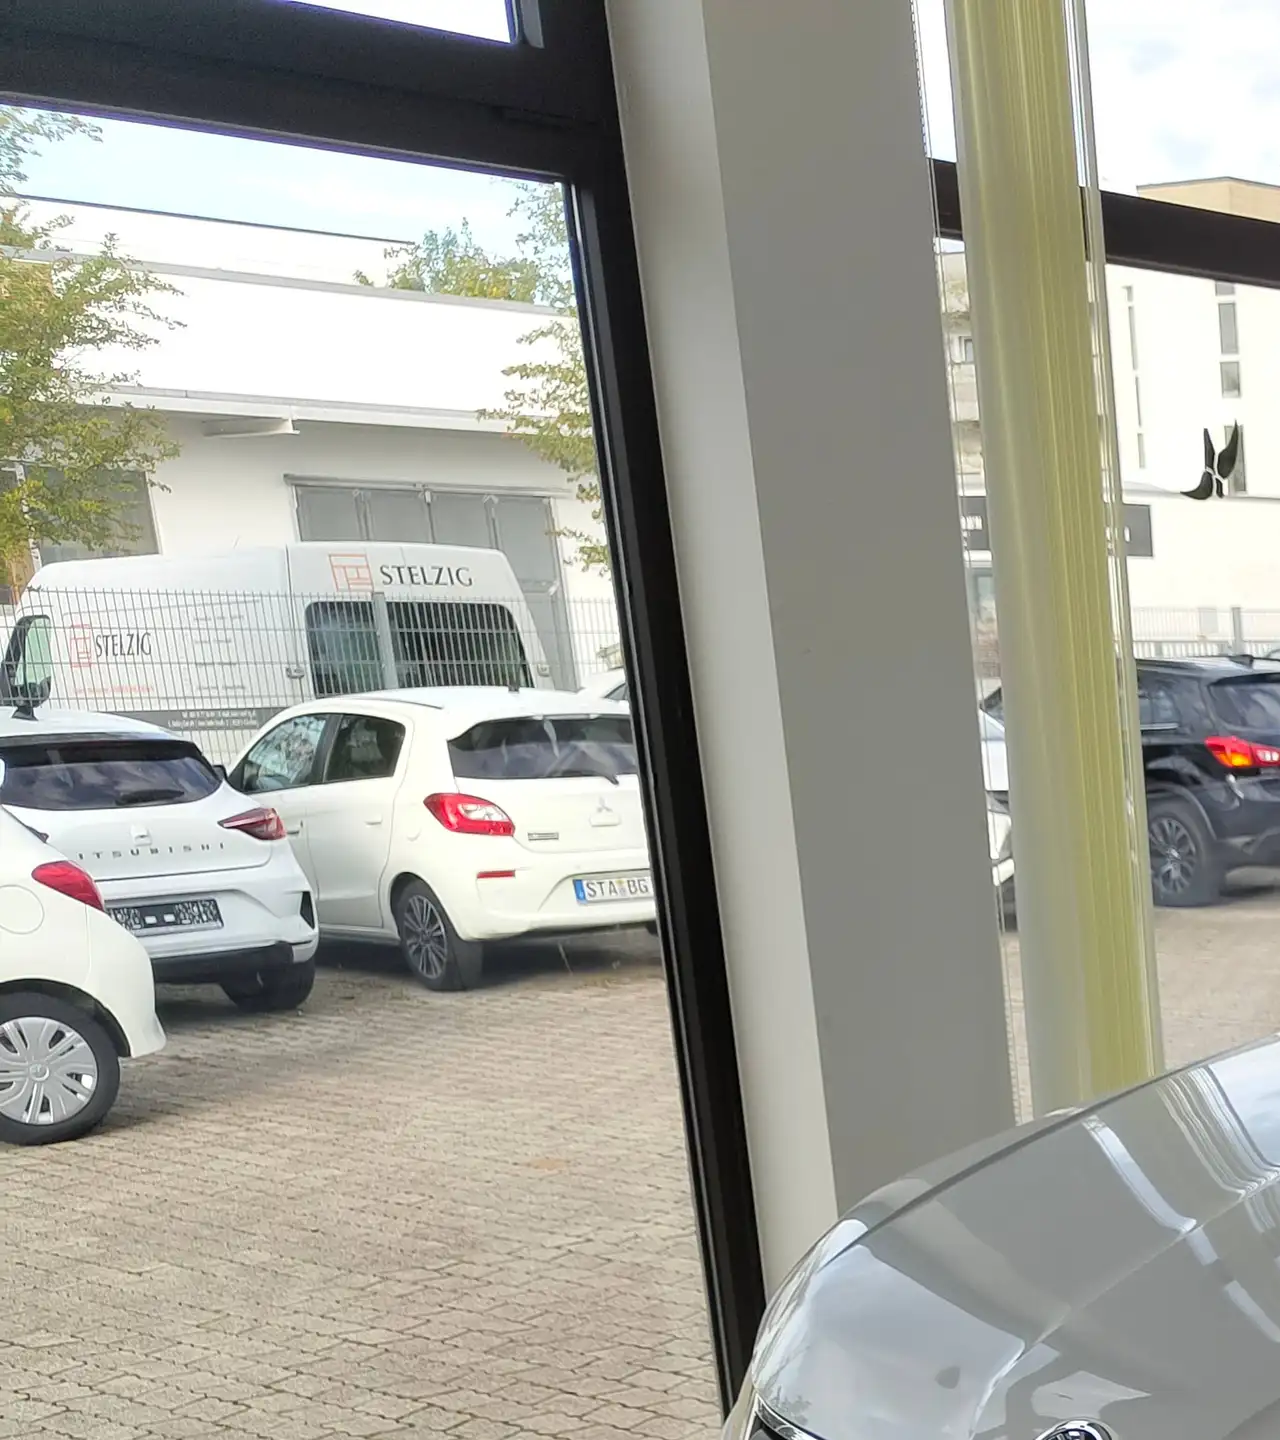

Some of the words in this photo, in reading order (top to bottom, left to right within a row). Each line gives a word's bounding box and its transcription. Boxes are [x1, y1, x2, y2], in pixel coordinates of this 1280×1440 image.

[379, 563, 473, 587] STELZIG
[95, 632, 152, 657] STELZIG
[78, 842, 224, 860] ITSUBISHI
[586, 881, 618, 898] STA
[627, 878, 649, 896] BG
